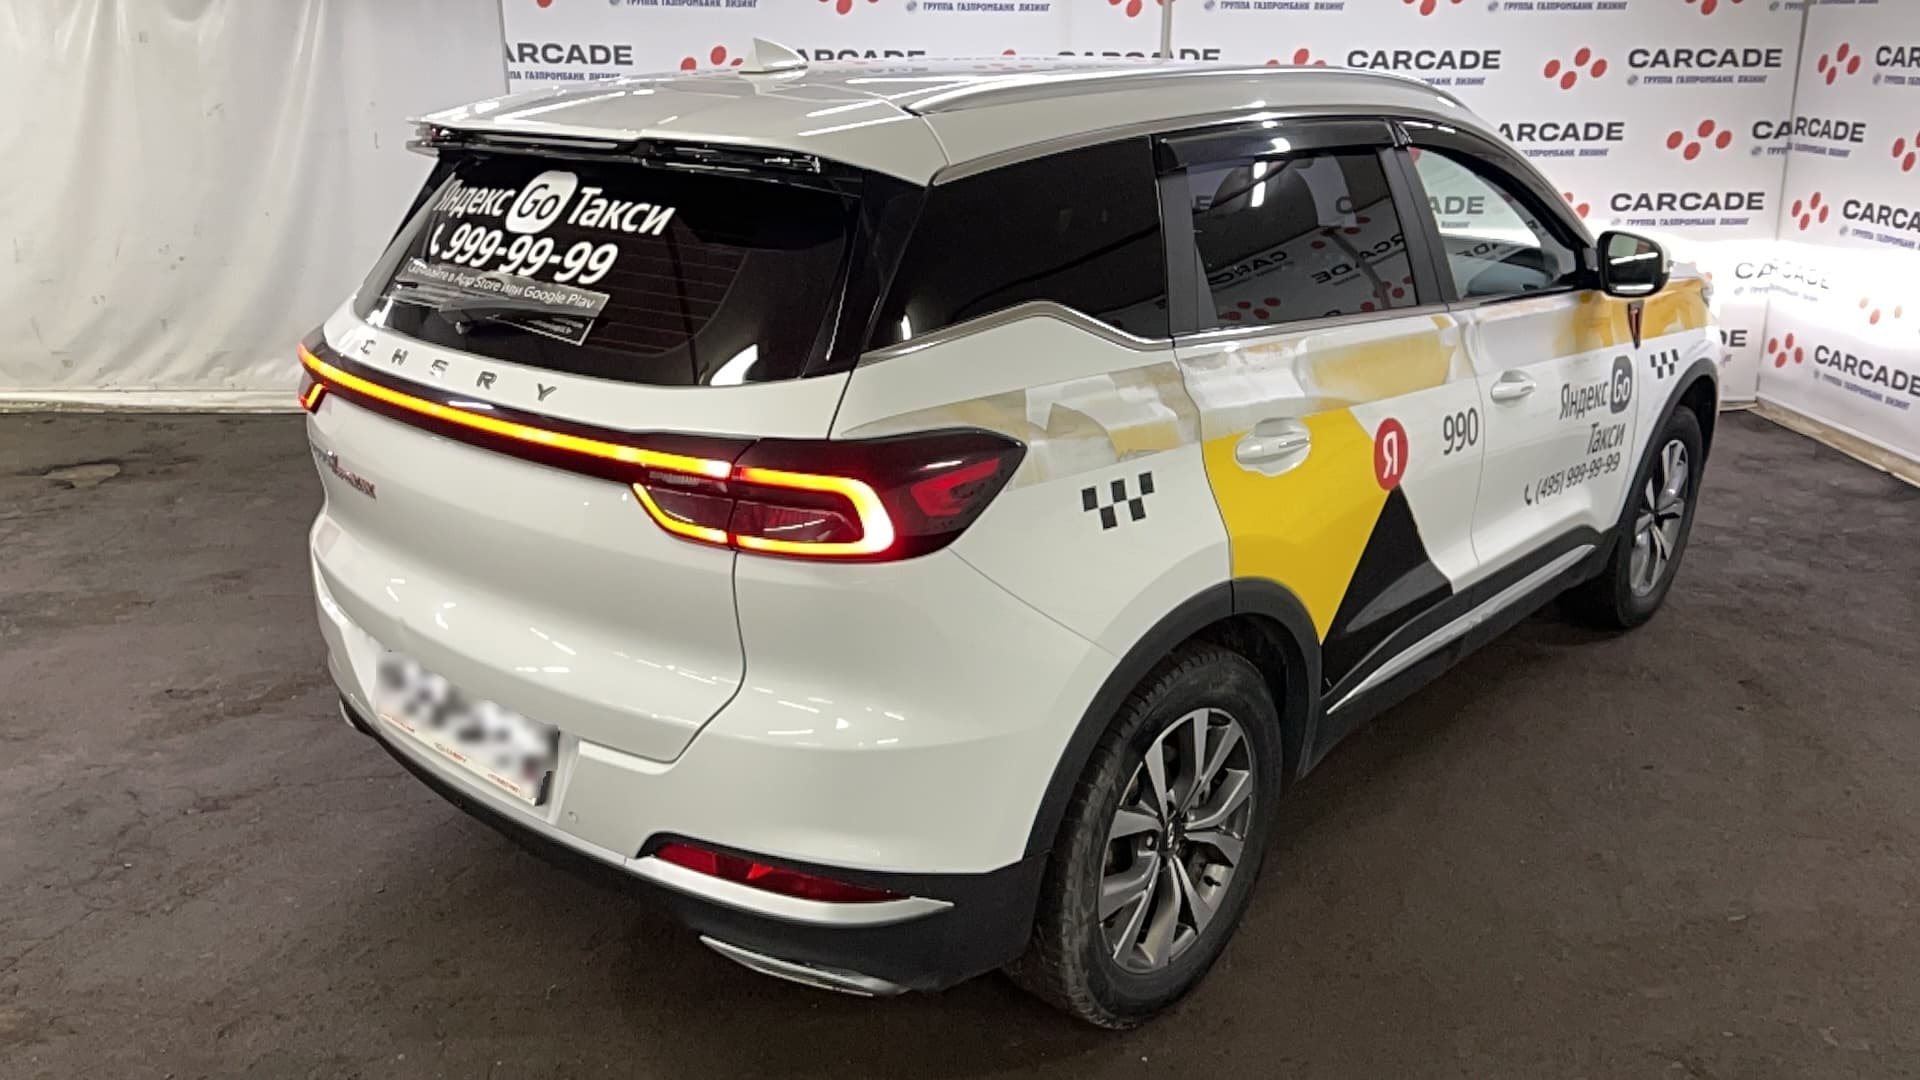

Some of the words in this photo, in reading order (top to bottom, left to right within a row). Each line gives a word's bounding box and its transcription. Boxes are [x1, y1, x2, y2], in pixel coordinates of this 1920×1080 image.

[923, 2, 953, 11] ГРУППА
[957, 3, 1015, 11] ГАЗПРОМБАНК
[1018, 3, 1050, 12] ЛИЗИНГ
[1220, 1, 1250, 9] ГРУППА
[1254, 1, 1310, 10] ГАЗПРОМБАНК
[1313, 2, 1344, 11] ЛИЗИНГ
[1503, 2, 1534, 10] ГРУППА
[1537, 2, 1593, 10] ГАЗПРОМБАНК
[1596, 2, 1628, 10] ЛИЗИНГ
[505, 42, 633, 66] ARCADE
[1347, 49, 1501, 70] CARCADE
[1628, 48, 1783, 69] CARCADE
[525, 71, 585, 81] ГАЗПРОМБАНК
[1499, 121, 1625, 141] ARCADE
[1751, 116, 1867, 143] CARCADE
[433, 178, 517, 219] Яндекс
[516, 183, 561, 220] Go
[566, 186, 676, 236] Такси
[1610, 191, 1765, 212] CARCADE
[1842, 199, 1920, 233] CARCA
[441, 223, 619, 285] 999-99-99
[474, 276, 502, 292] Store
[523, 286, 566, 304] Google
[360, 338, 557, 402] CHERY
[1814, 344, 1920, 398] CARCADE
[1559, 381, 1609, 420] Яндекс
[1443, 407, 1479, 456] 990
[1586, 423, 1626, 455] Такси
[1382, 430, 1399, 480] Я
[1534, 469, 1565, 504] (495)
[1565, 451, 1621, 489] 999-99-99
